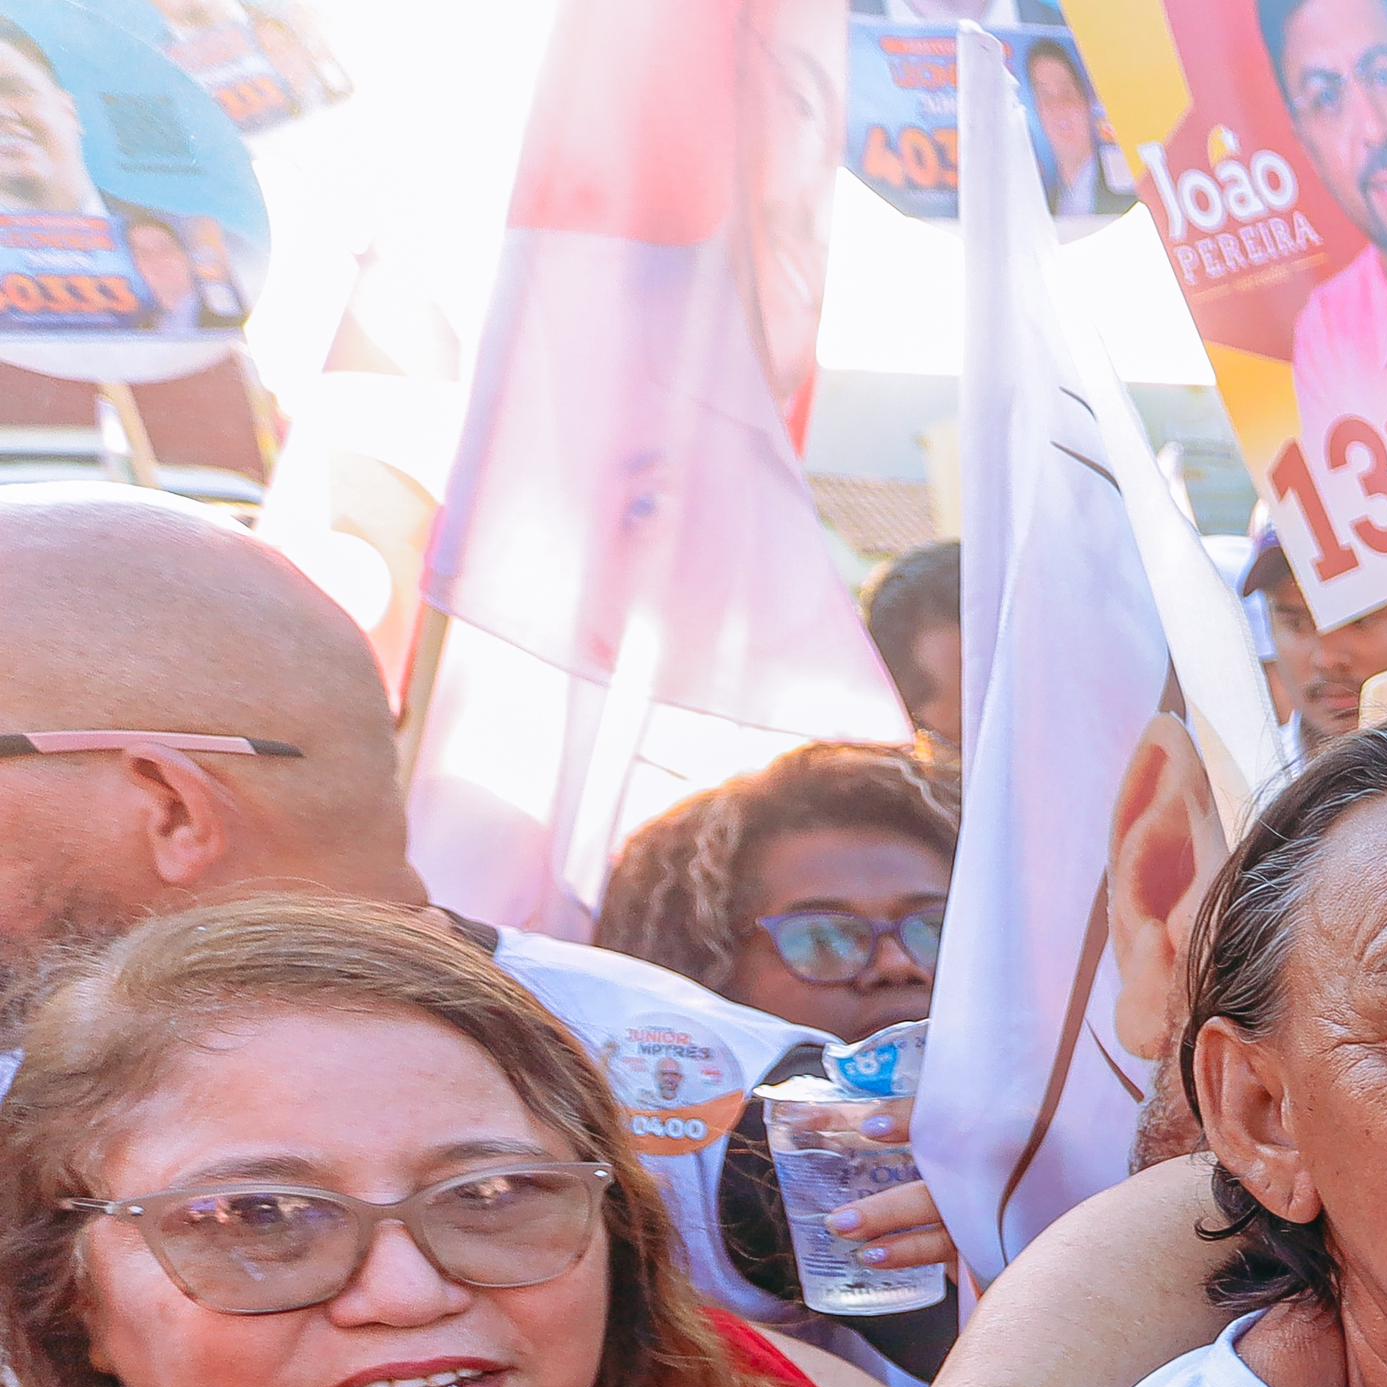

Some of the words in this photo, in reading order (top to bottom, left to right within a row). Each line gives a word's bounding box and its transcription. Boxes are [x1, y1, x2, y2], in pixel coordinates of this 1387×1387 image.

[1137, 124, 1299, 241] João
[1173, 211, 1324, 286] PEREIRA
[624, 1116, 709, 1140] 0400
